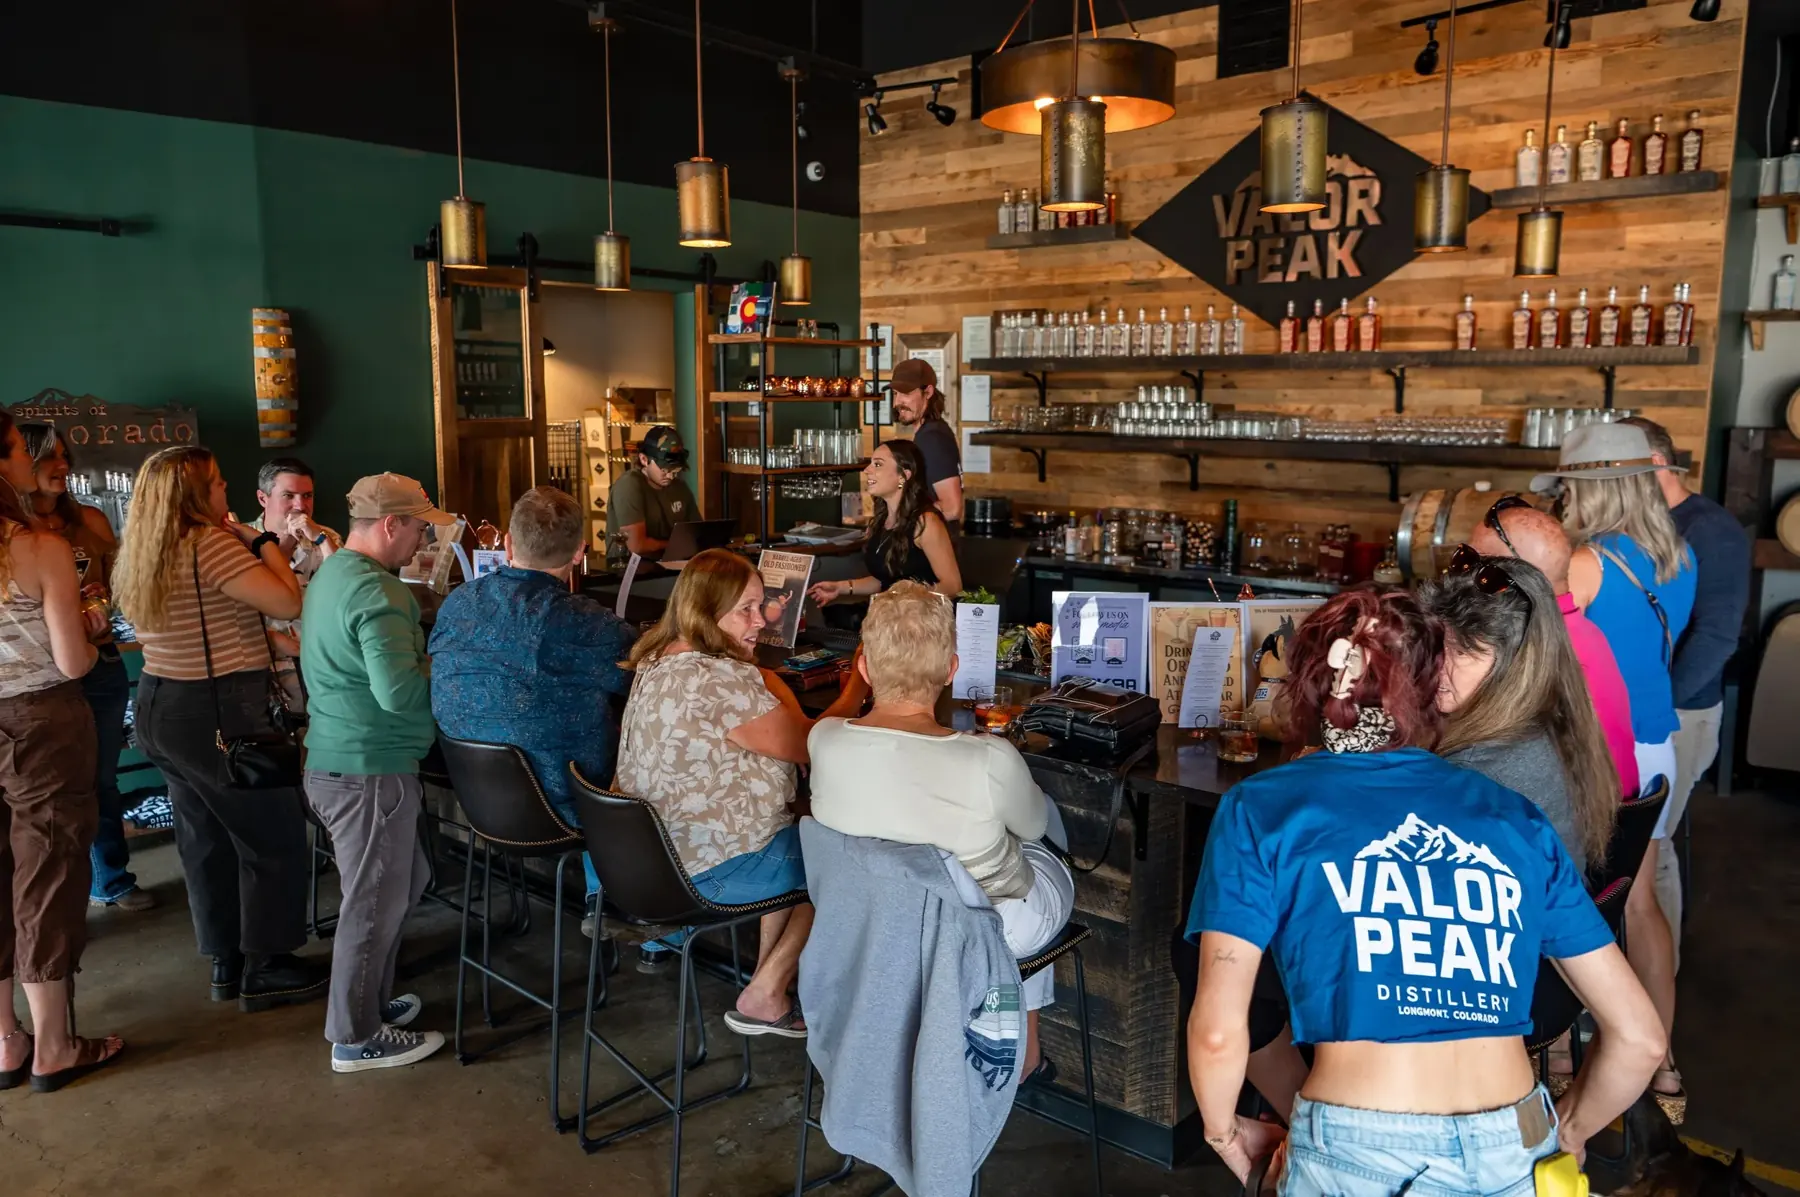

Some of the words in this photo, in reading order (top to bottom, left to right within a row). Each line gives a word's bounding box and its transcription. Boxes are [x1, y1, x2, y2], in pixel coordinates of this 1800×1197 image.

[1226, 229, 1364, 286] PEAK
[15, 404, 80, 419] spirits
[88, 404, 108, 416] of
[42, 418, 194, 445] orado
[763, 560, 775, 569] OLD
[774, 561, 807, 573] FASHIONED
[1117, 611, 1129, 619] ON
[1099, 617, 1129, 632] media
[1165, 645, 1192, 658] DRIN
[1321, 860, 1524, 932] VALOR
[1353, 916, 1518, 989] PEAK
[1377, 984, 1509, 1013] DISTILLERY
[1453, 1010, 1499, 1024] COLORADO
